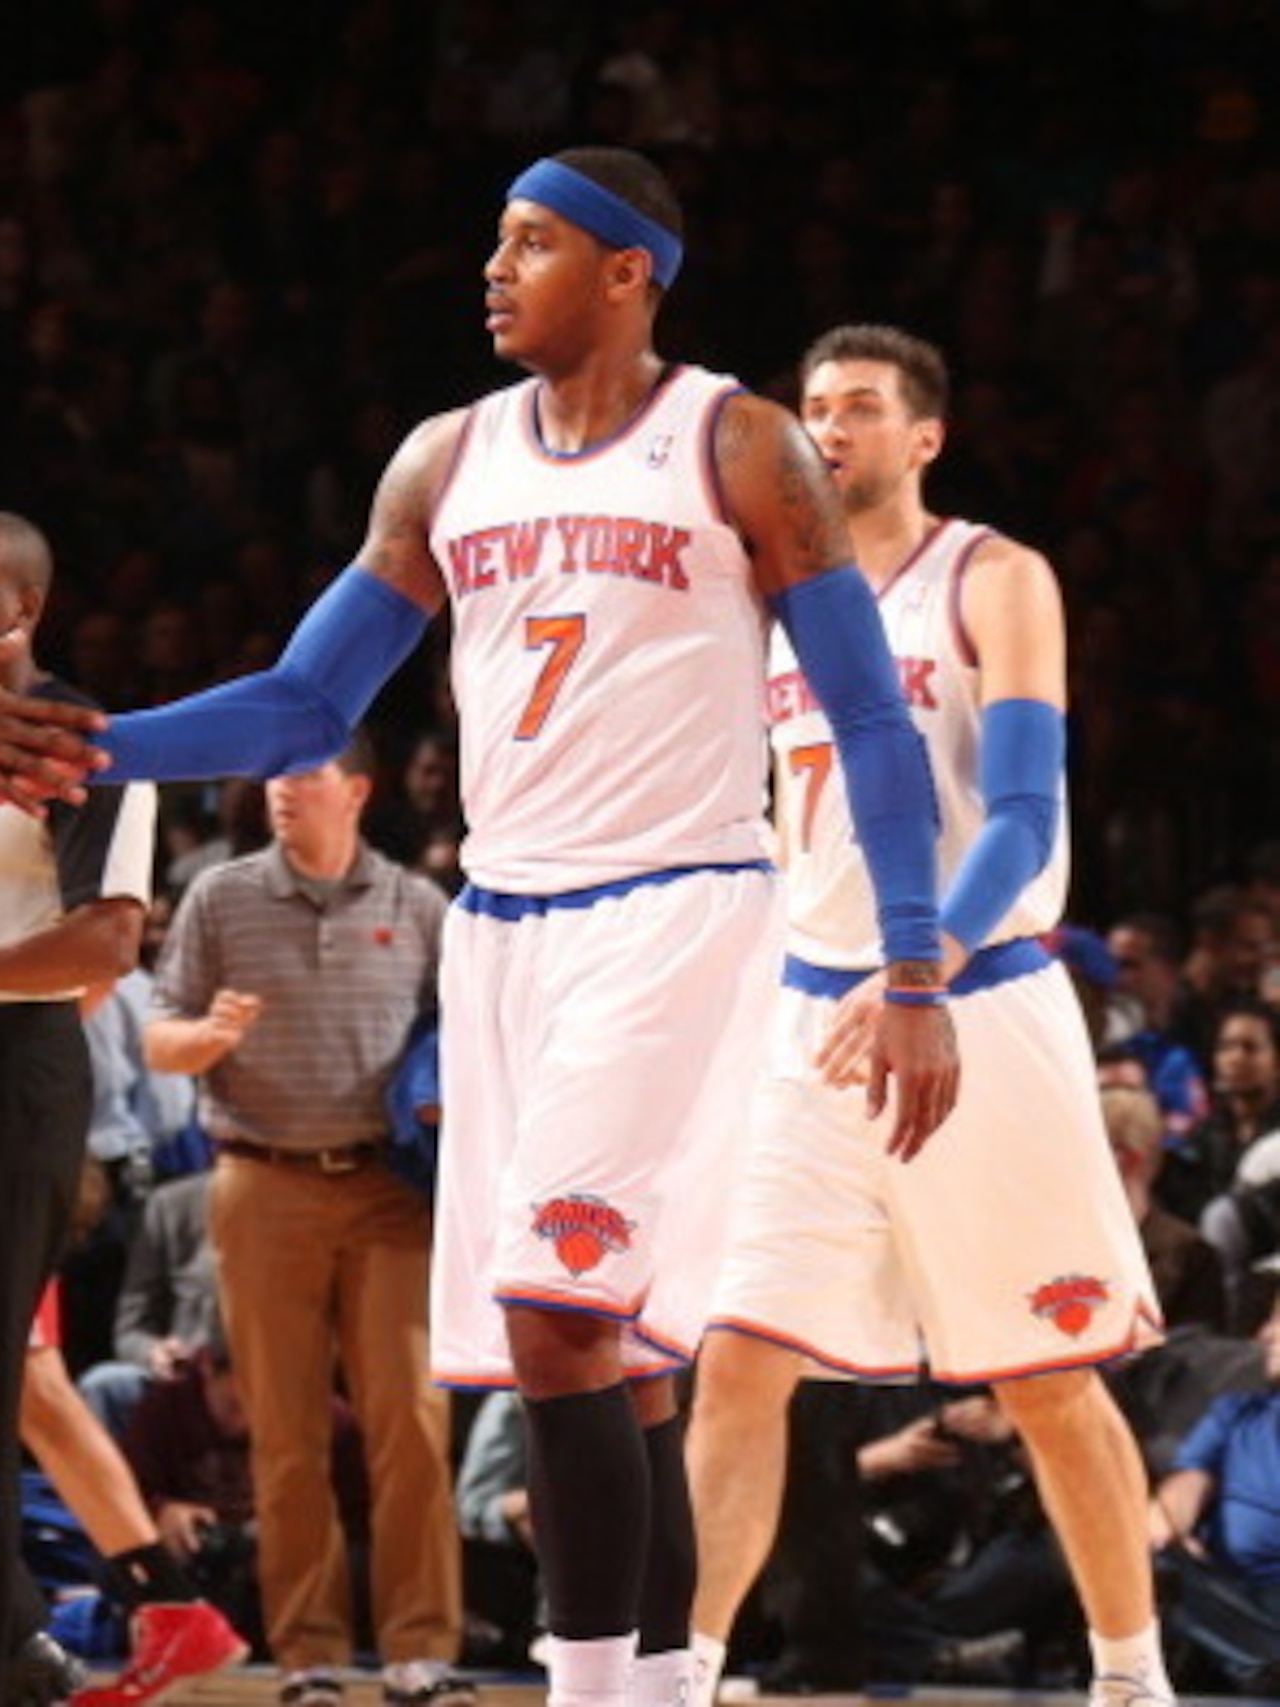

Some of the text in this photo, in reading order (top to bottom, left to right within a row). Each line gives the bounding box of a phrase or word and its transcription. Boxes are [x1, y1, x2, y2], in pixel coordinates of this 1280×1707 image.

[448, 513, 691, 600] NEW YORK
[513, 612, 586, 742] 7
[787, 741, 834, 853] 7
